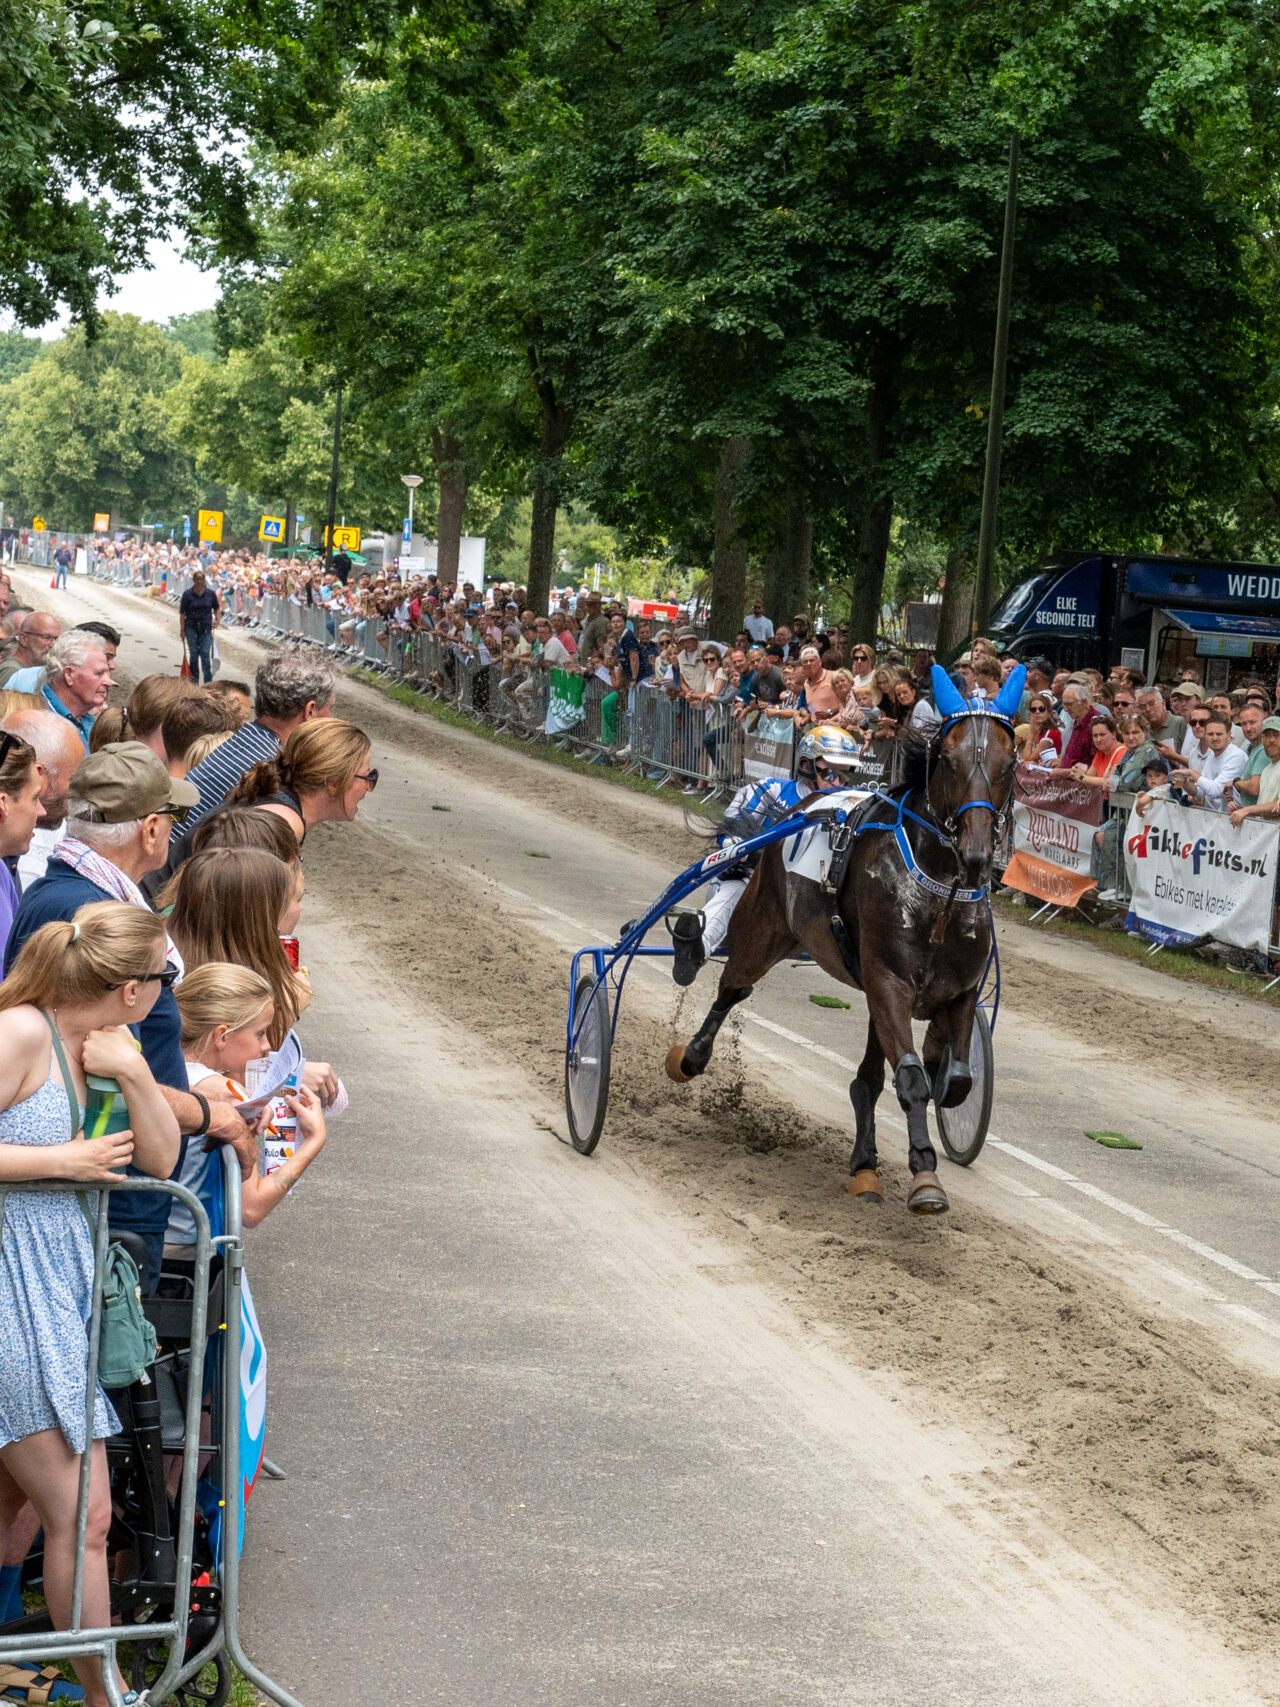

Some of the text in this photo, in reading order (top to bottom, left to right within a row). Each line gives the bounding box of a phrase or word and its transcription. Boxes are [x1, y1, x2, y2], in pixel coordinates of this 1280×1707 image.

[342, 533, 350, 543] R
[1056, 596, 1077, 610] ELKE
[1036, 611, 1096, 628] SECONDE TELT
[1025, 806, 1080, 854] RIJNLAND
[1128, 825, 1267, 878] dikkefiets.nl
[911, 866, 921, 880] DE
[1154, 875, 1185, 905] Ebikes
[1186, 890, 1204, 911] met
[264, 1146, 280, 1158] Rulo
